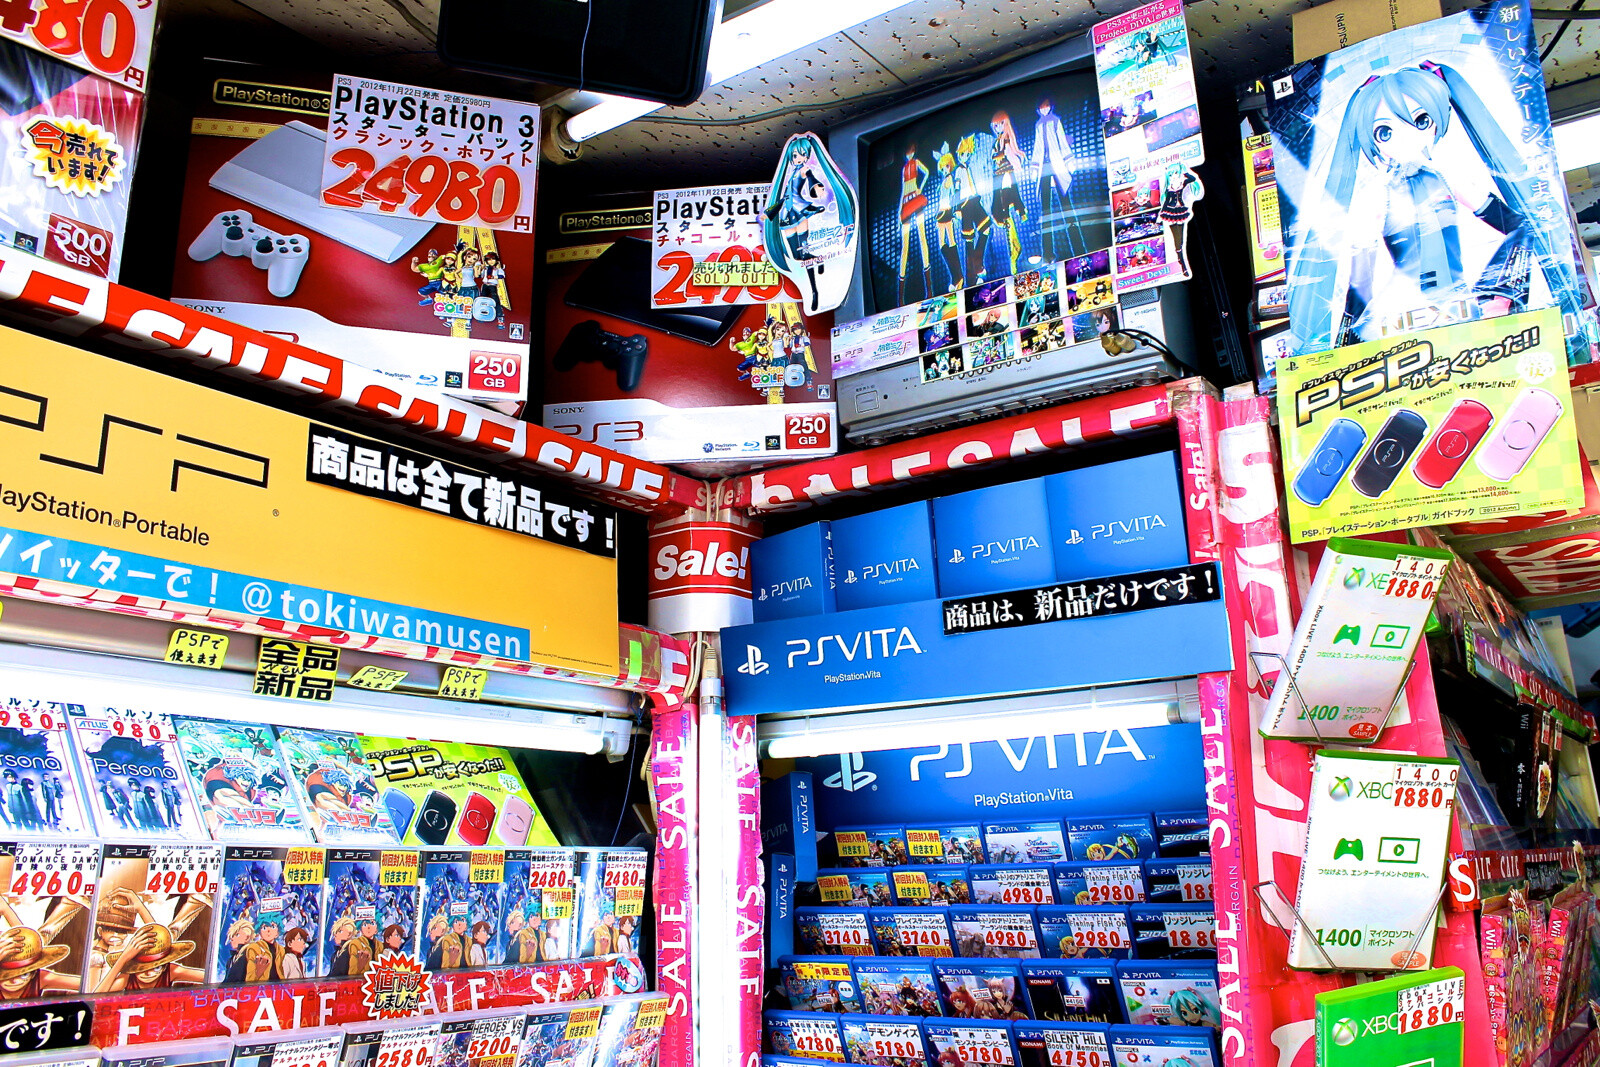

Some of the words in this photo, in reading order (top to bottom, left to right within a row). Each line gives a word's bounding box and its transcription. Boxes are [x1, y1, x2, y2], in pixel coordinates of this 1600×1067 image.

[335, 86, 503, 134] PlayStation
[518, 115, 535, 138] 3
[333, 126, 533, 168] クラシック・ホワイト
[53, 221, 108, 257] 500
[64, 251, 91, 268] GB
[693, 273, 730, 285] SOLD
[741, 273, 777, 285] OUT!
[1117, 272, 1145, 288] Sweet
[185, 304, 225, 314] SONY
[473, 355, 517, 377] 250
[482, 377, 506, 389] GB
[750, 374, 785, 385] GOLF
[553, 407, 584, 415] SONY
[788, 417, 827, 435] 250
[798, 437, 818, 446] GB
[654, 541, 750, 580] Sale!
[1394, 558, 1448, 576] 1400
[242, 581, 522, 658] @tokiwamusen
[254, 671, 333, 702] 新品
[1297, 704, 1339, 722] 1400
[1520, 713, 1529, 730] Wii
[93, 757, 178, 780] Persona
[1396, 767, 1458, 782] 1400
[732, 722, 759, 834] SALE
[1200, 707, 1232, 850] SALE
[659, 734, 690, 852] SALE
[14, 855, 66, 864] ROMANCE
[71, 855, 100, 864] DAWN
[149, 856, 193, 864] ROMANCE
[197, 856, 222, 864] DAWN
[243, 849, 273, 858] PSP
[344, 851, 371, 860] PSP
[437, 853, 464, 861] PSP
[1315, 928, 1363, 948] 1400
[1369, 930, 1416, 939] マイクロソフト
[1550, 920, 1562, 938] Wii
[736, 884, 761, 998] SALE
[1367, 938, 1396, 947] ポイント
[1484, 928, 1497, 950] Wii
[660, 898, 690, 1018] SALE
[374, 968, 421, 993] 値下げ
[1213, 910, 1246, 1060] SALE
[511, 1018, 525, 1030] VS
[540, 1014, 564, 1023] PSP
[1045, 1033, 1081, 1044] SILENT
[1083, 1035, 1106, 1045] HILL
